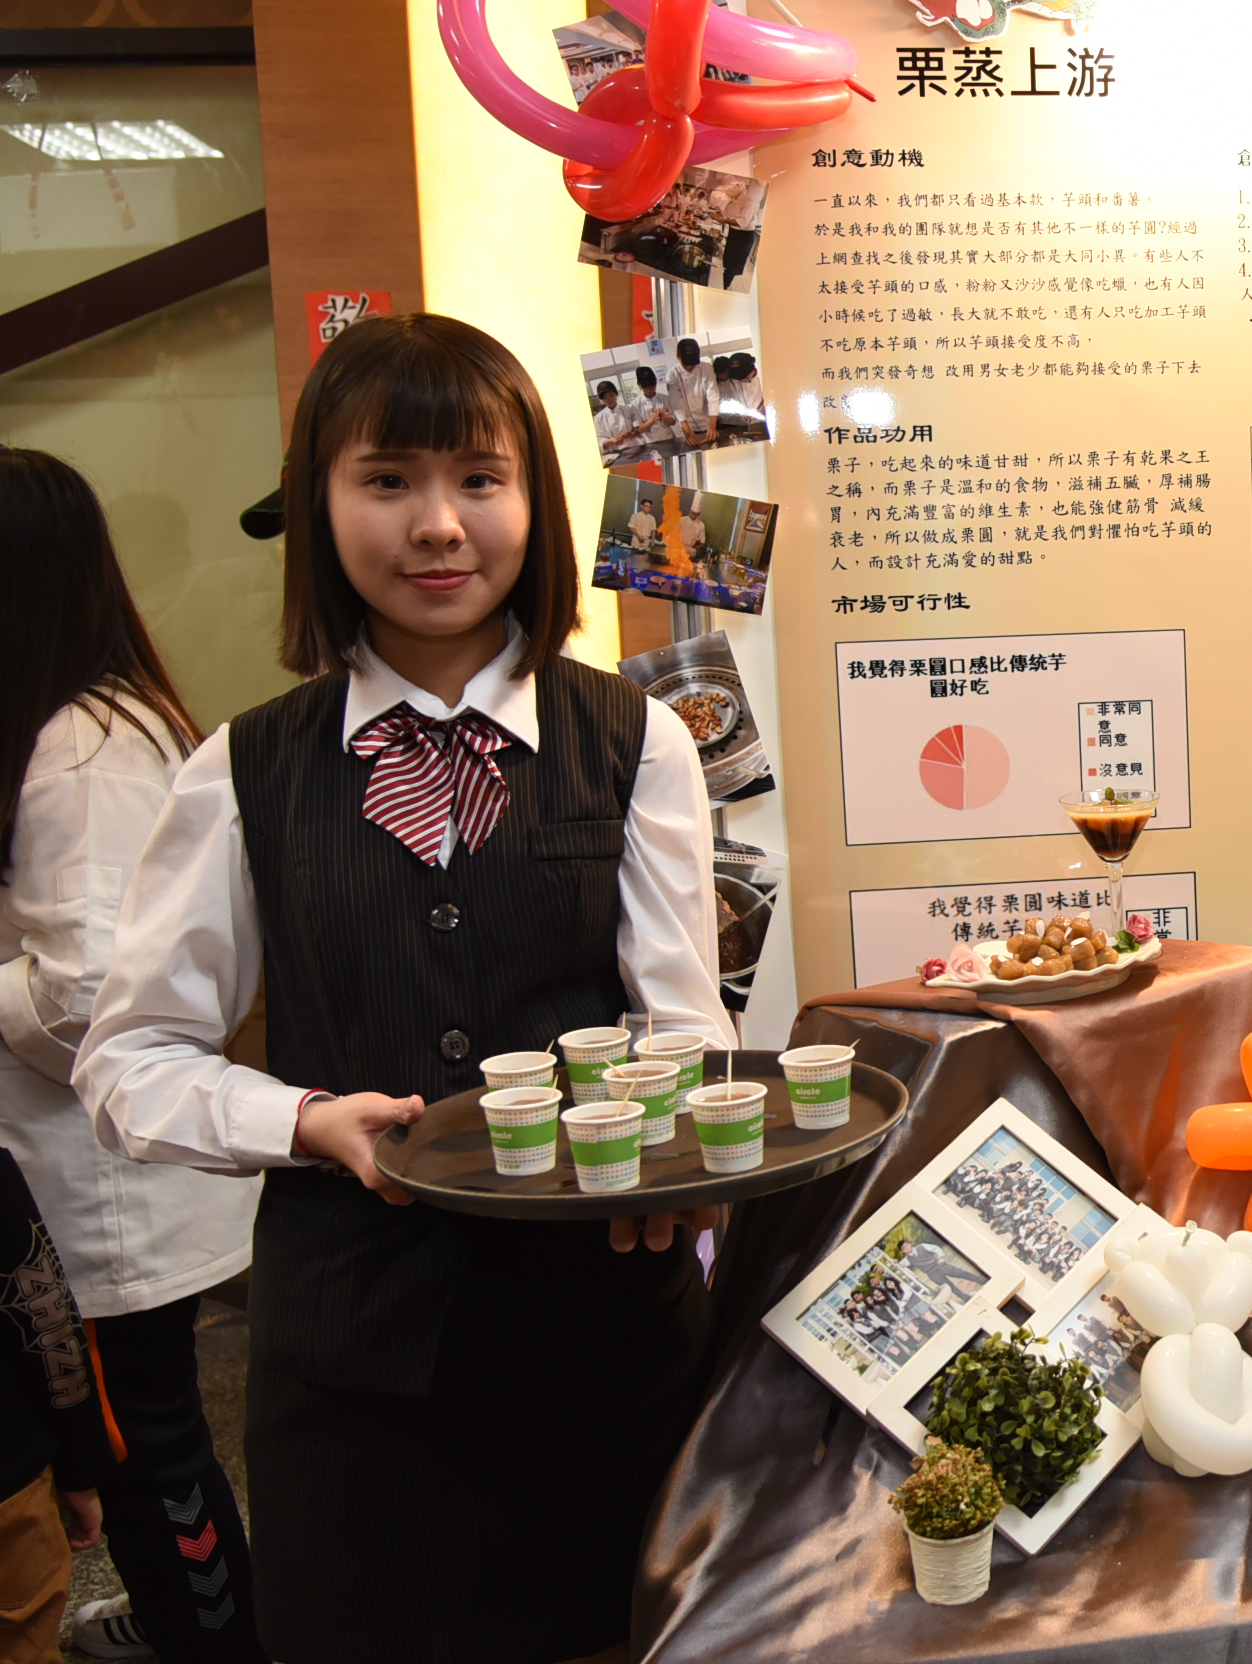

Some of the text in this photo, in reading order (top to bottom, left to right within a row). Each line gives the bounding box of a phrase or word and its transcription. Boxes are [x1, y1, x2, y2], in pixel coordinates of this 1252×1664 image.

[896, 47, 1116, 98] 栗蒸上游
[811, 148, 925, 168] 創意動機
[821, 363, 936, 381] 而我們突發奇想
[823, 425, 934, 445] 作品功用
[1171, 497, 1206, 514] 減緩
[832, 592, 970, 615] 市場可行性
[847, 653, 1067, 680] 我覺得栗圓口感比傳統芋
[1097, 702, 1142, 717] 非常同
[1098, 719, 1111, 734] 意
[1099, 733, 1128, 748] 同意
[1099, 762, 1144, 777] 沒意見
[1152, 910, 1170, 926] 非
